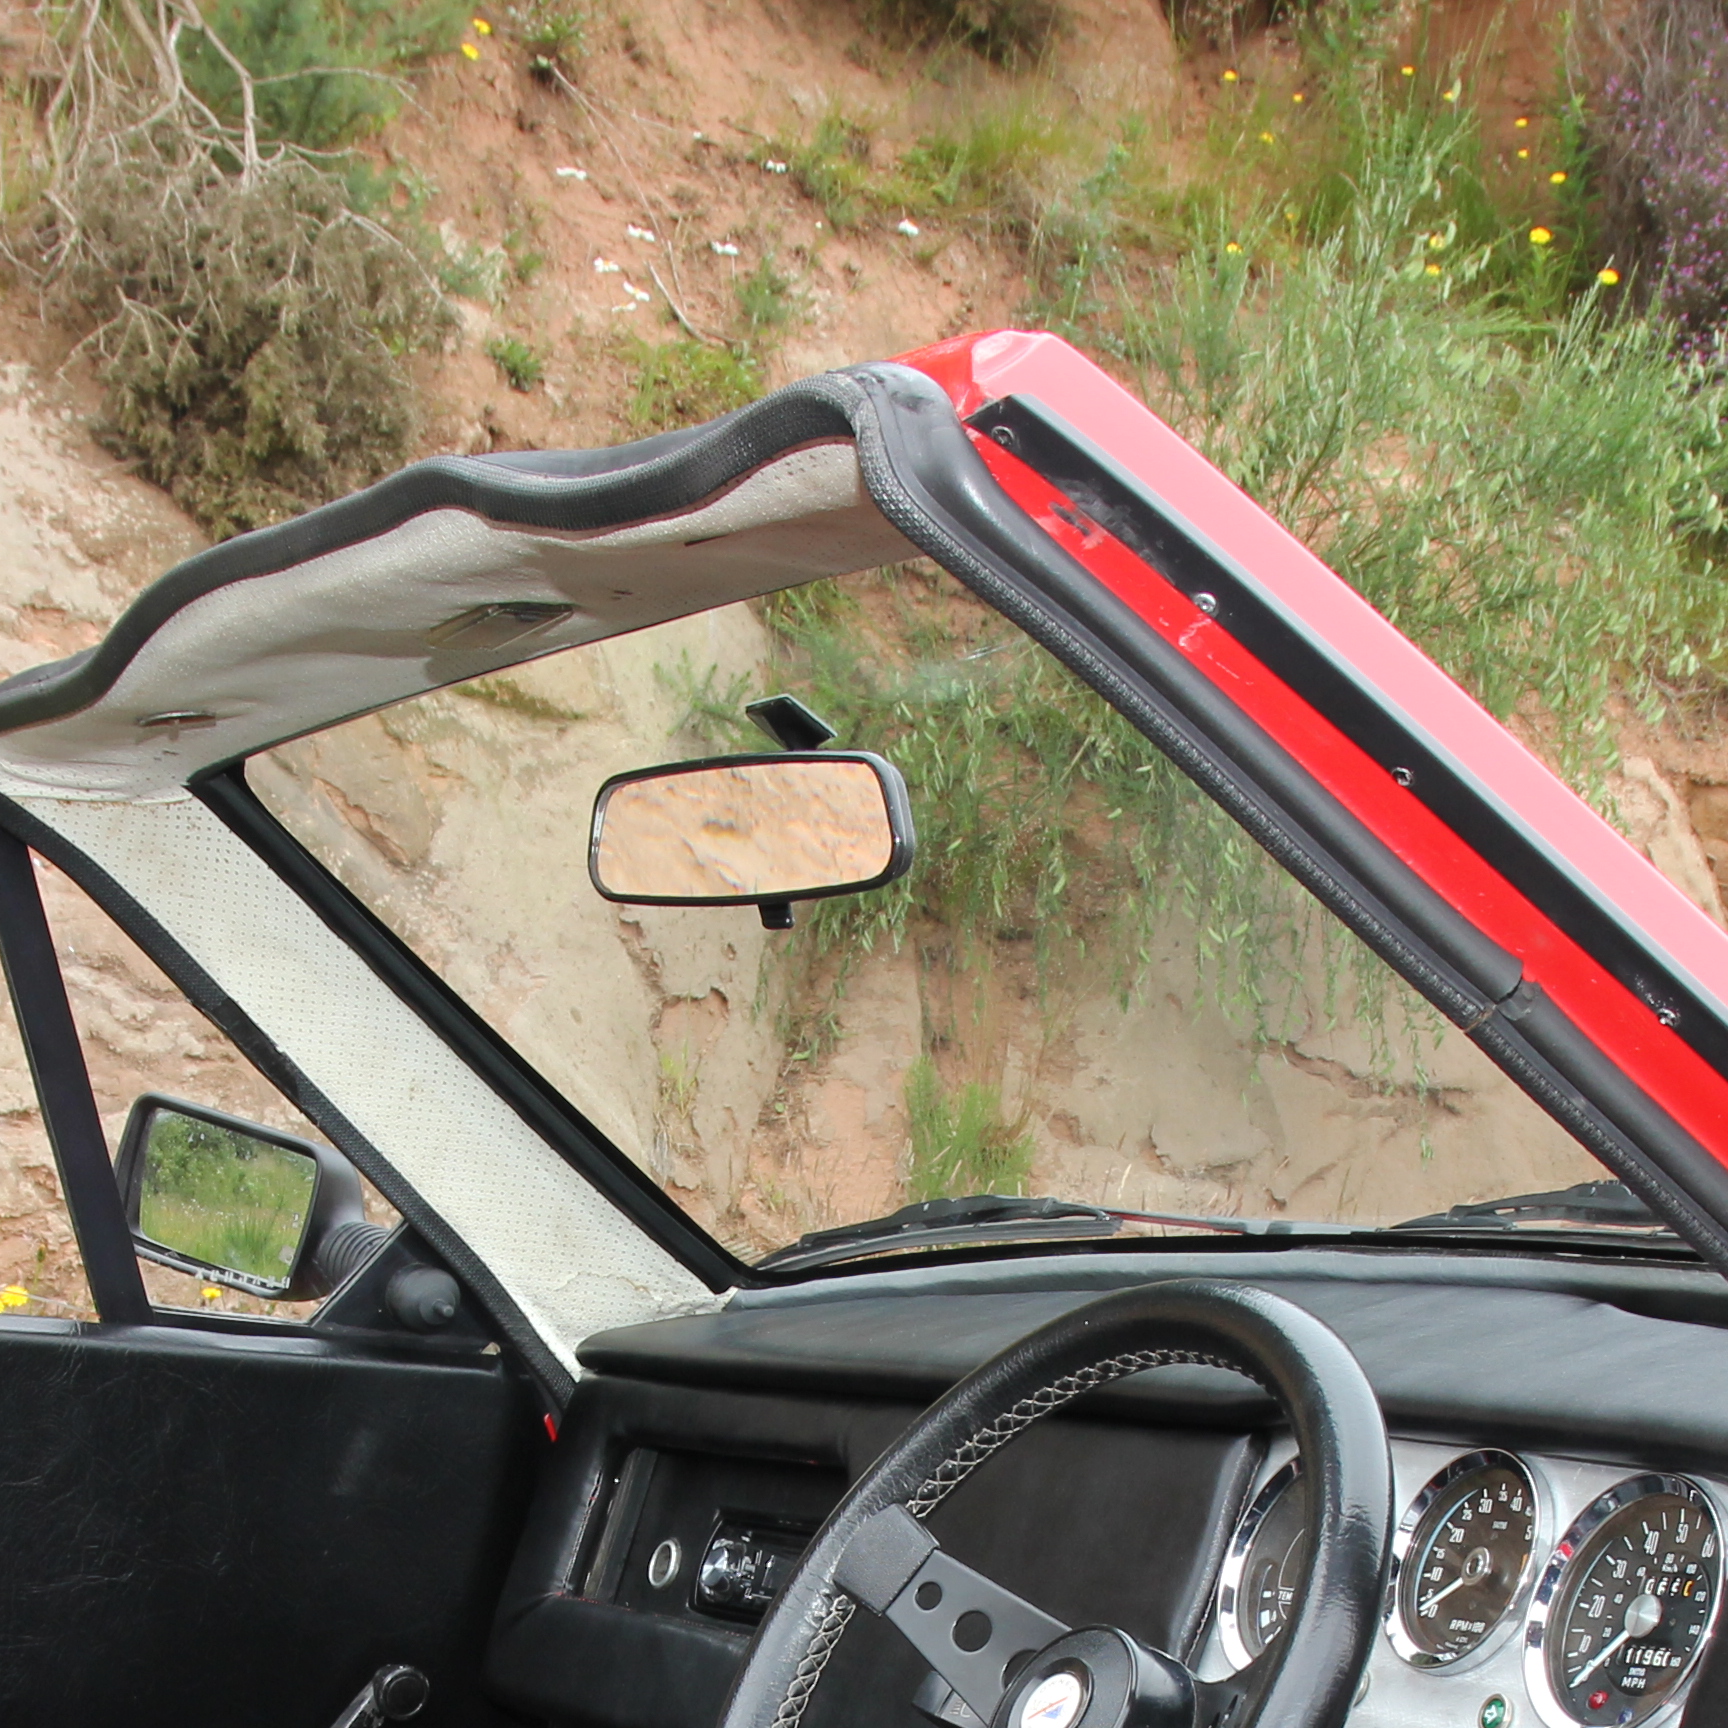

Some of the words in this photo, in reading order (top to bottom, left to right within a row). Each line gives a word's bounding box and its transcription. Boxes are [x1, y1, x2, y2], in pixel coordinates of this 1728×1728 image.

[1478, 1499, 1493, 1513] 30
[1510, 1497, 1522, 1512] 40
[1462, 1509, 1473, 1520] 25
[1449, 1528, 1465, 1543] 20
[1675, 1523, 1689, 1543] 50
[1644, 1531, 1660, 1555] 40
[1430, 1567, 1443, 1581] 10
[1612, 1559, 1627, 1579] 30
[1426, 1588, 1434, 1599] 5
[1428, 1604, 1438, 1618] 0
[1588, 1595, 1606, 1618] 20
[1579, 1635, 1592, 1653] 10
[1622, 1676, 1647, 1689] MPH
